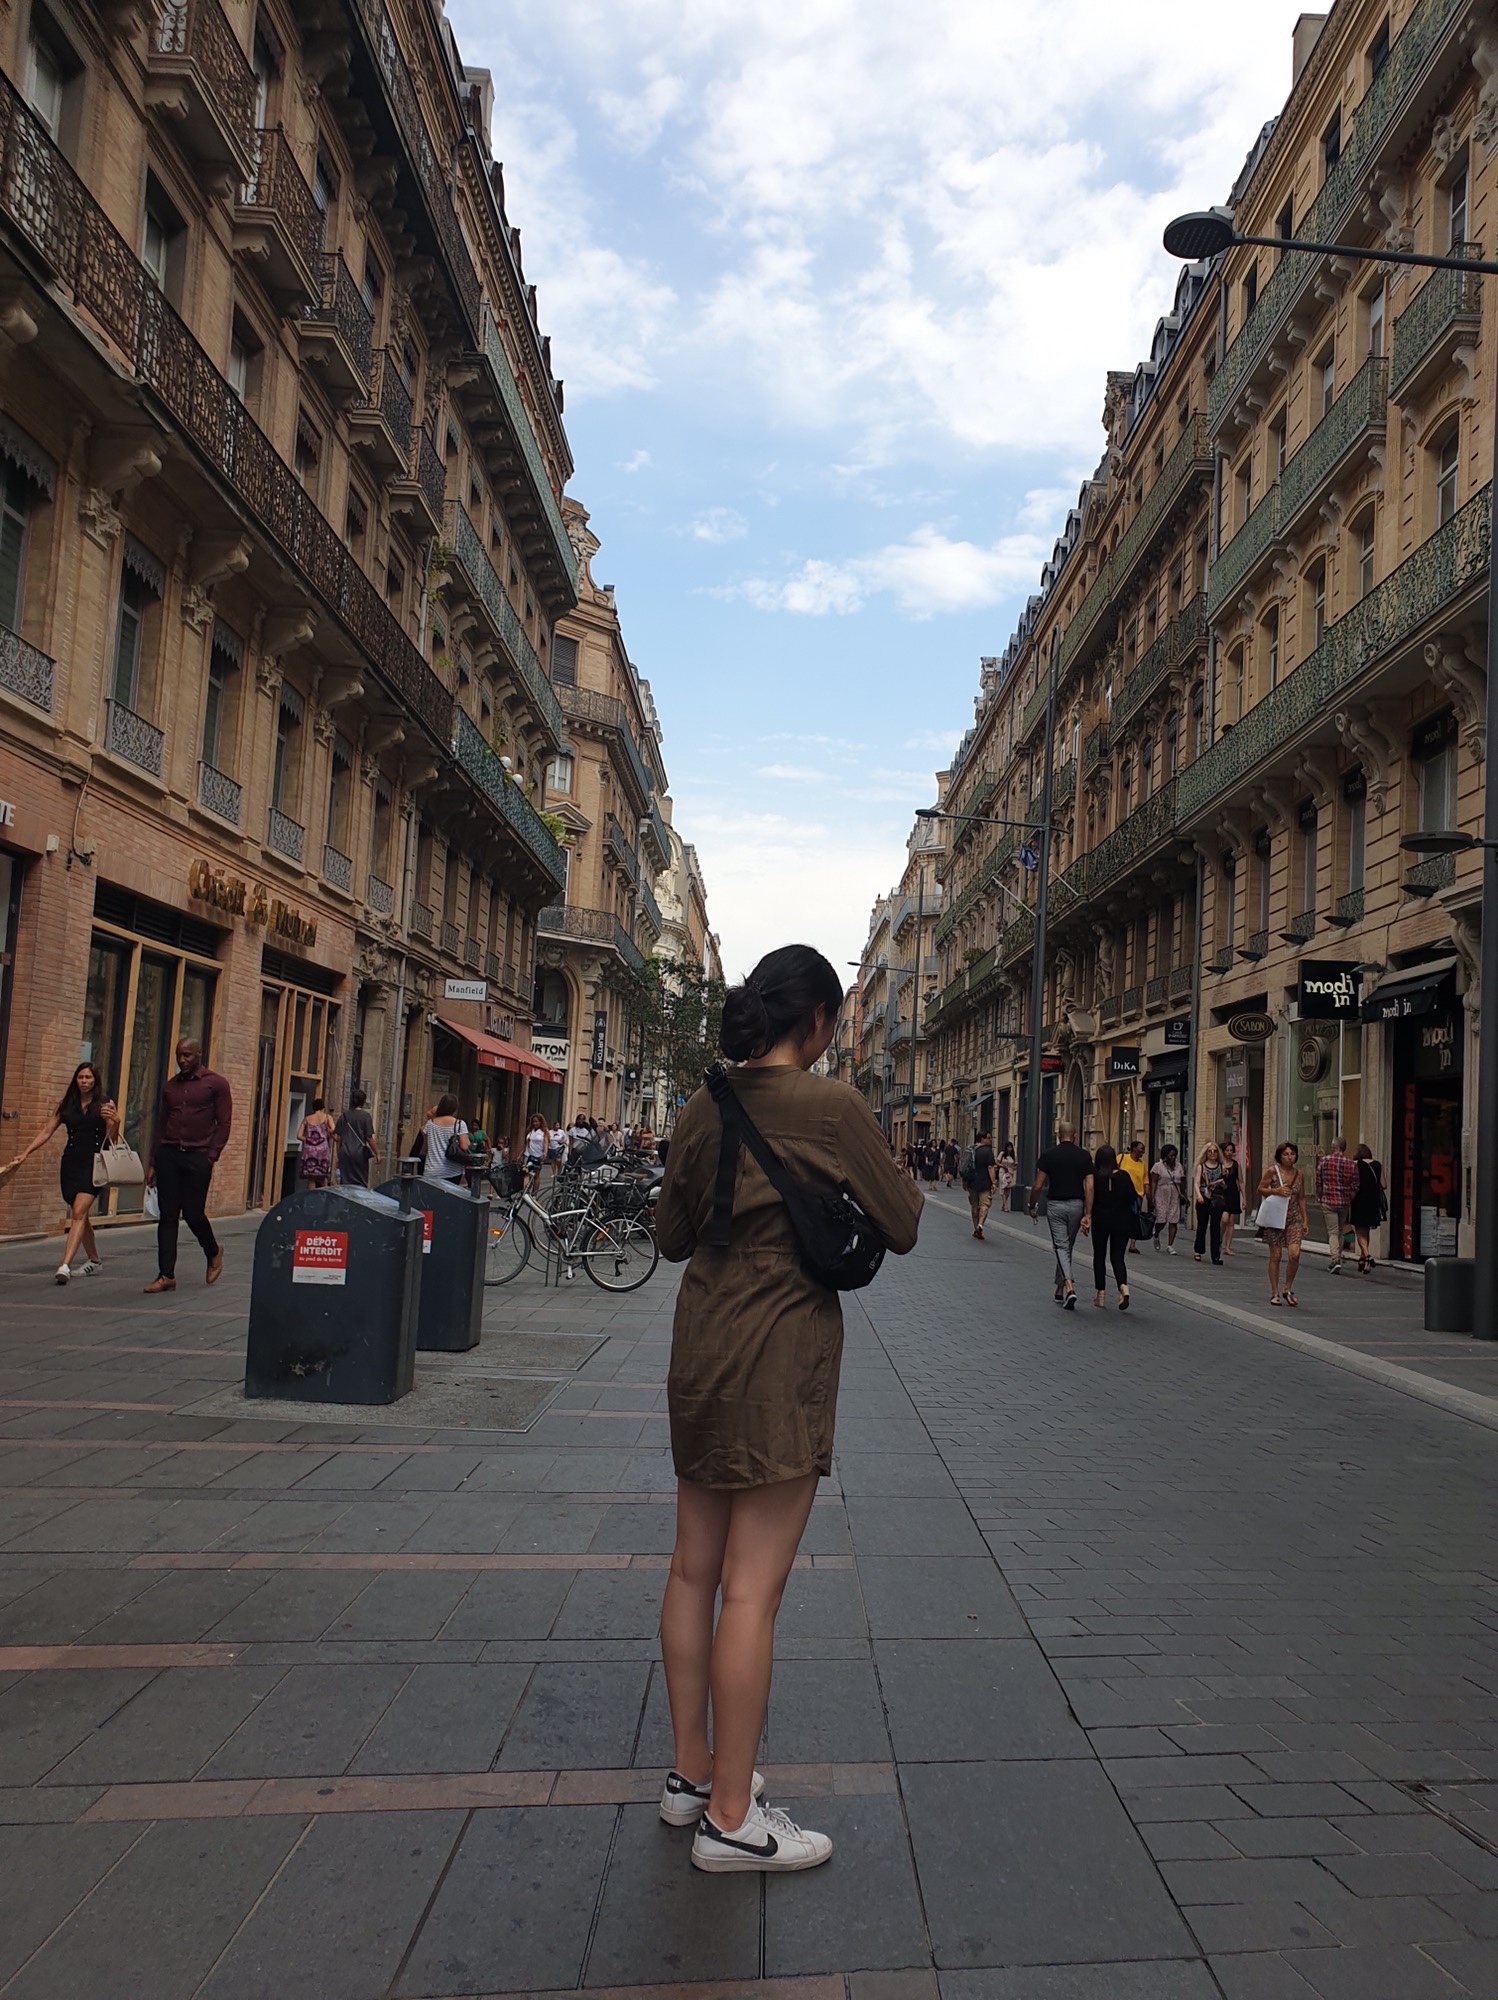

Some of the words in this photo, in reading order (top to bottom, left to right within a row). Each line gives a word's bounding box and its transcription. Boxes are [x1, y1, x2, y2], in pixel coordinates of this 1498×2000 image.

[1304, 973, 1355, 994] modi
[447, 985, 484, 995] Manfield
[1332, 991, 1350, 1007] in
[1240, 1021, 1265, 1031] SABON
[306, 1236, 337, 1246] DÉPÔT
[300, 1246, 342, 1256] INTERDIT
